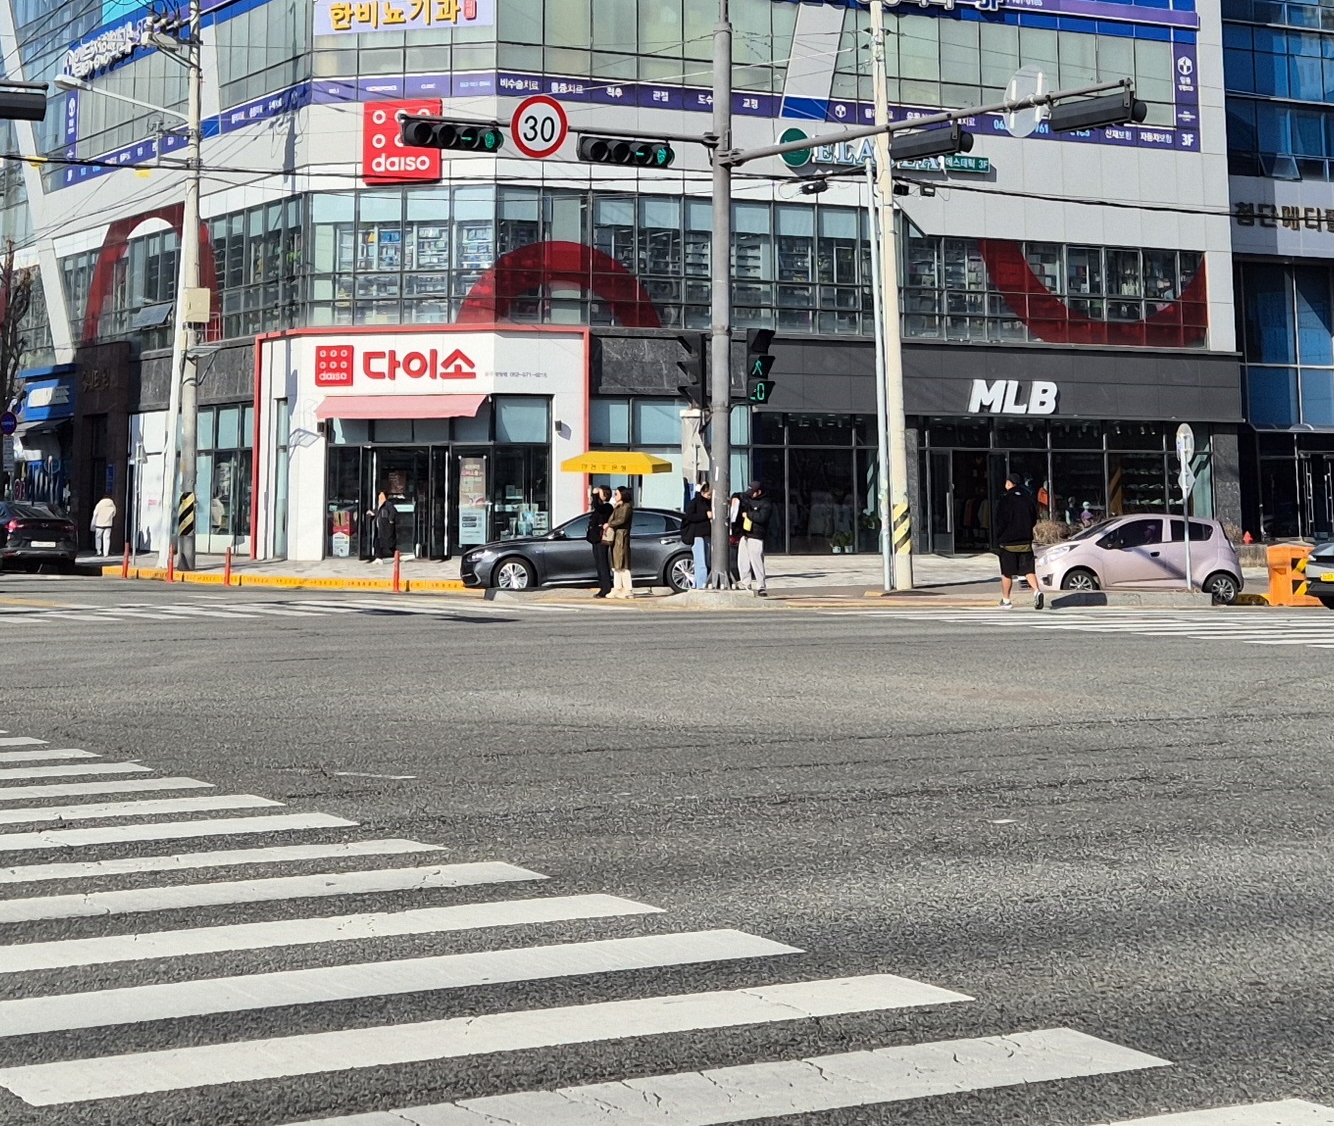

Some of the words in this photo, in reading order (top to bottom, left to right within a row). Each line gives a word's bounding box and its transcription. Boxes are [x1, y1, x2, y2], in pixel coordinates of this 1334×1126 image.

[523, 114, 555, 143] 30
[1104, 129, 1132, 141] 산재보험
[1140, 130, 1173, 144] 자동차보험
[1181, 133, 1194, 147] 3F
[371, 153, 430, 173] daiso
[978, 159, 989, 169] 3F
[362, 348, 477, 380] 다이소
[318, 371, 348, 381] daiso
[969, 379, 1059, 415] MLB
